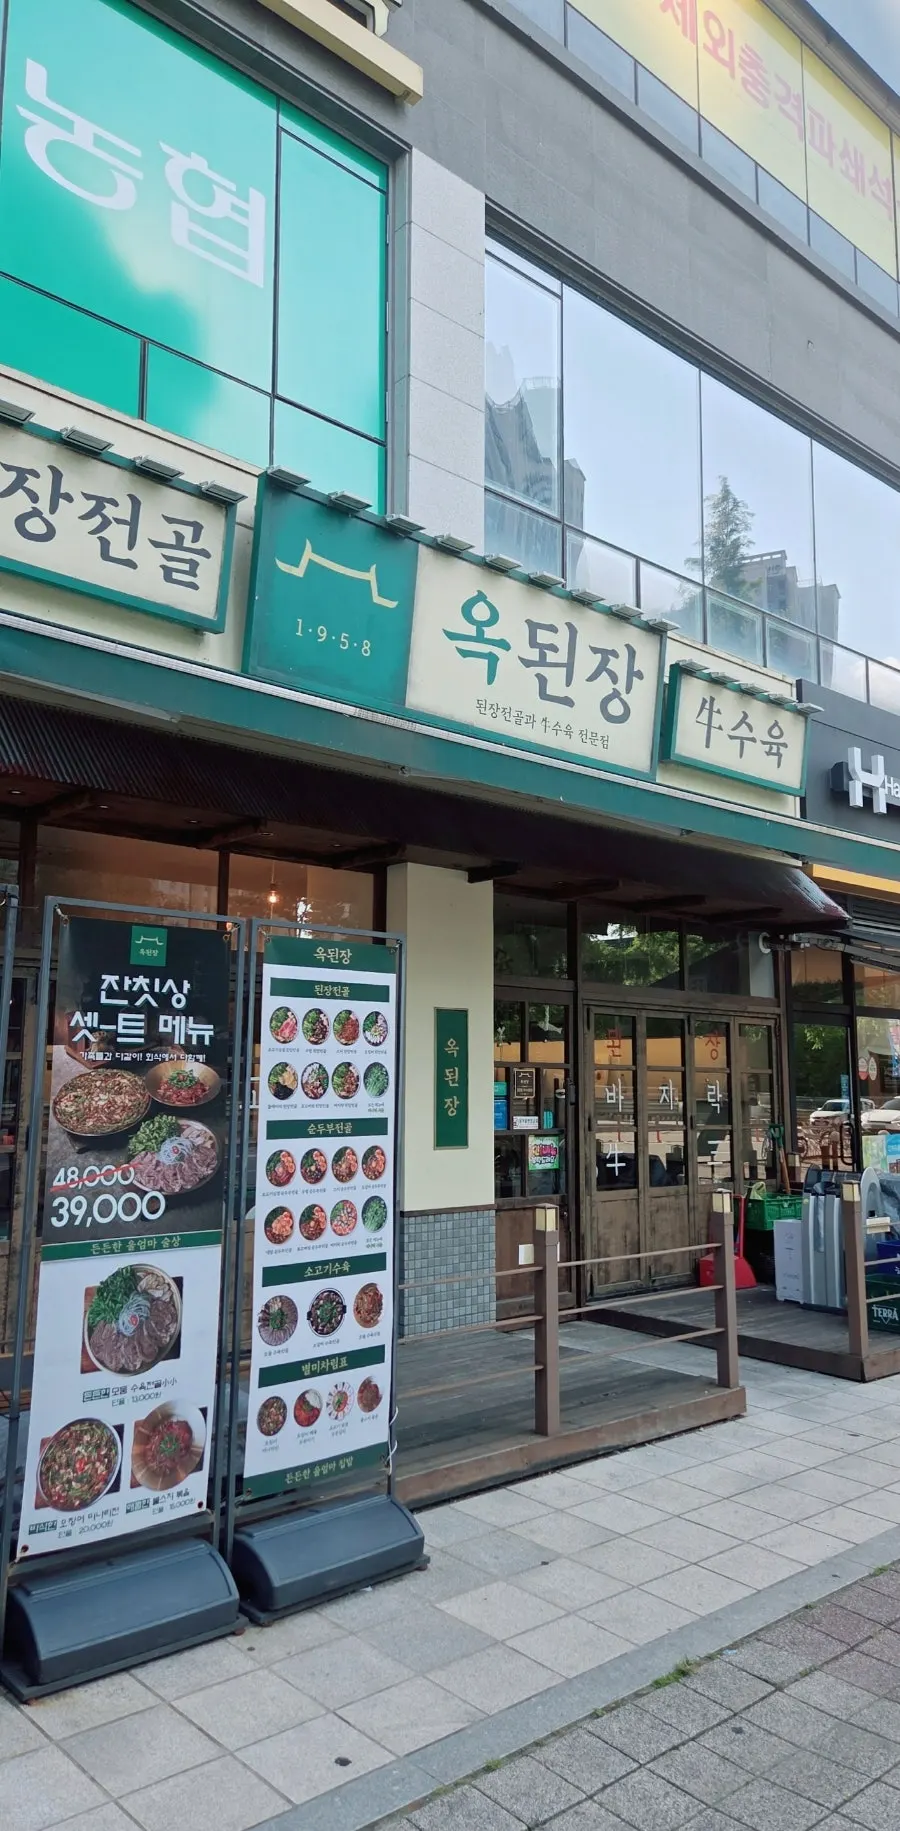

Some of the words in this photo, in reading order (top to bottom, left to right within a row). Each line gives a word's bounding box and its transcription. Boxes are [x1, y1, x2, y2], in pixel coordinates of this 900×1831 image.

[16, 58, 266, 288] 농협
[0, 464, 212, 591] 장전골
[442, 589, 644, 724] 옥된장
[475, 698, 537, 729] 된장전골과
[578, 729, 610, 750] 전문점
[695, 695, 788, 768] 牛수육
[313, 946, 352, 965] 옥된장
[100, 974, 191, 1009] 잔칫상
[314, 984, 350, 997] 된장전골
[158, 1014, 215, 1046] 메뉴
[444, 1037, 460, 1117] 옥된장
[307, 1122, 353, 1135] 순두부전골
[52, 1164, 135, 1190] 48,000
[50, 1190, 166, 1228] 39,000
[90, 1240, 122, 1255] 든든한
[304, 1261, 351, 1278] 소고기수육
[871, 1304, 899, 1321] TERRA
[301, 1356, 348, 1376] 별미차림표
